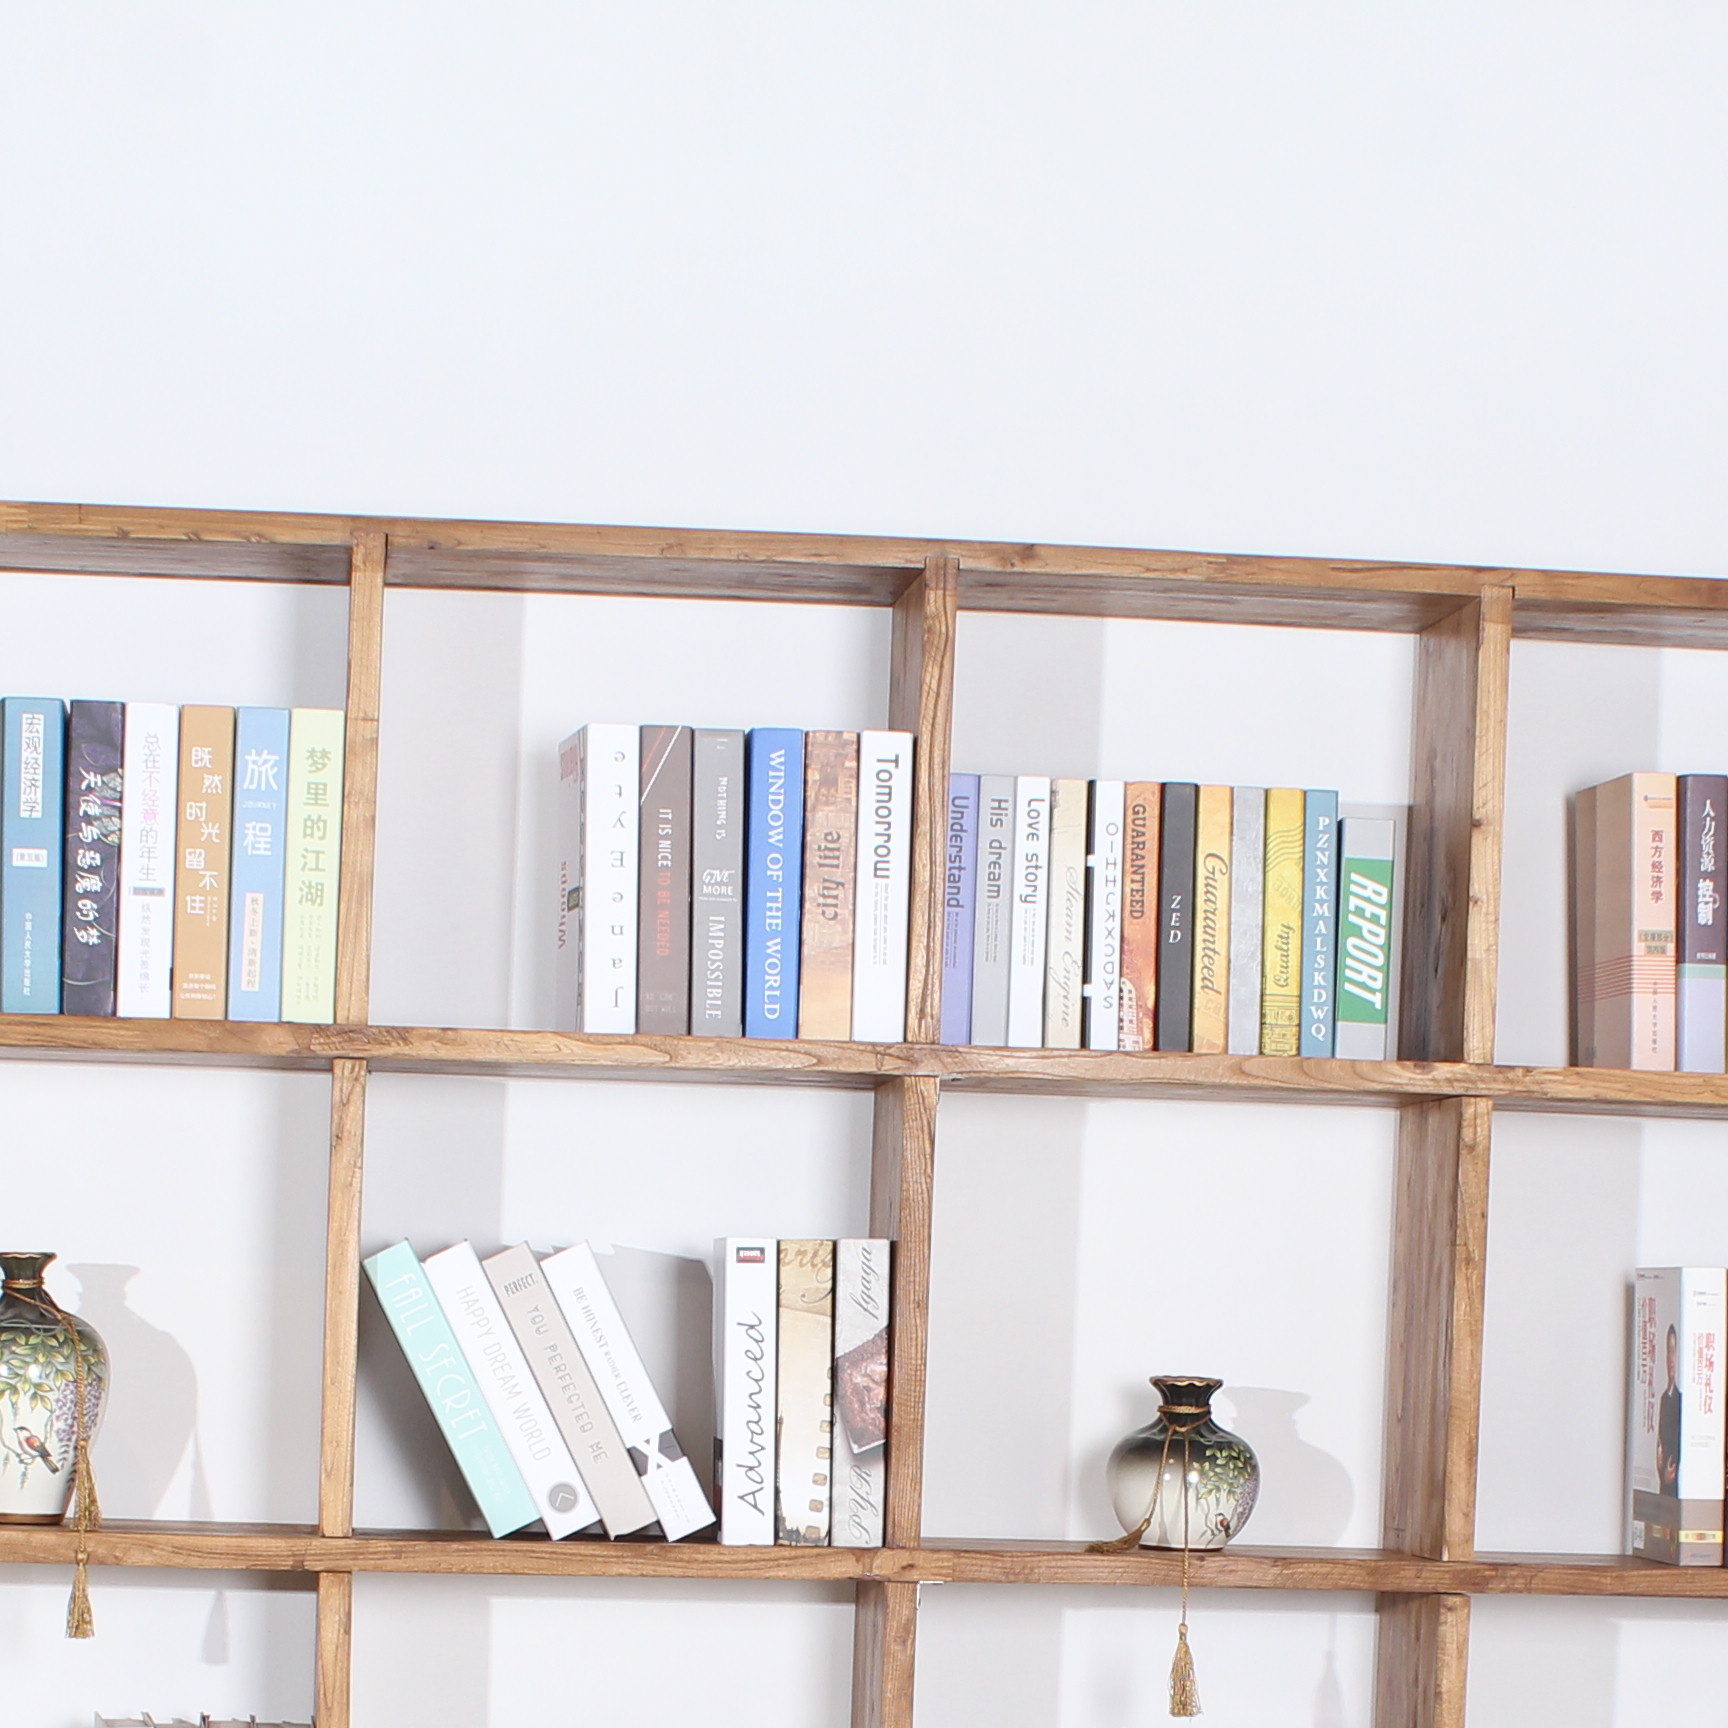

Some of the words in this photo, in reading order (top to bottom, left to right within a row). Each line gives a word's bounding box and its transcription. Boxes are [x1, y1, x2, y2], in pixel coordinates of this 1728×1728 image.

[22, 713, 42, 817] 宏观经济学
[137, 732, 162, 882] 总在不经意的年生
[767, 748, 785, 847] WINDOW
[184, 746, 224, 916] 既然时光留不住
[296, 746, 333, 908] 梦里的江湖
[657, 841, 672, 868] NICE
[658, 808, 672, 820] IT
[658, 824, 672, 837] IS
[873, 753, 901, 880] Tomorrow
[946, 795, 971, 910] Understand
[989, 797, 1009, 829] His
[1026, 798, 1046, 843] Love
[1700, 799, 1717, 872] 人力资源
[74, 766, 104, 946] 天使与恶魔的梦
[657, 872, 671, 885] TO
[657, 891, 671, 904] BE
[702, 885, 734, 896] MORE
[766, 852, 784, 883] OF
[986, 838, 1008, 900] dream
[1019, 852, 1046, 905] story
[1129, 803, 1148, 920] GUARANTEED
[1649, 829, 1665, 904] 西方经济学
[656, 909, 670, 956] NEEDED
[765, 888, 783, 932] THE
[1200, 852, 1229, 996] Guaranteed
[1343, 871, 1389, 1011] REPORT
[1697, 878, 1719, 926] 控制
[705, 915, 726, 1020] IMPOSSIBLE
[764, 937, 782, 1021] WORLD
[1273, 922, 1297, 989] Quality
[418, 1343, 488, 1441] SECRET
[456, 1284, 498, 1341] HAPPY
[481, 1341, 523, 1402] DREAM
[512, 1401, 553, 1463] WORLD
[526, 1303, 551, 1337] YOU
[543, 1342, 595, 1434] PERFECTED
[588, 1439, 610, 1466] ME
[572, 1286, 589, 1306] BE
[581, 1303, 610, 1350] HONEST
[614, 1380, 644, 1426] CLEVER
[736, 1311, 767, 1516] Advanced
